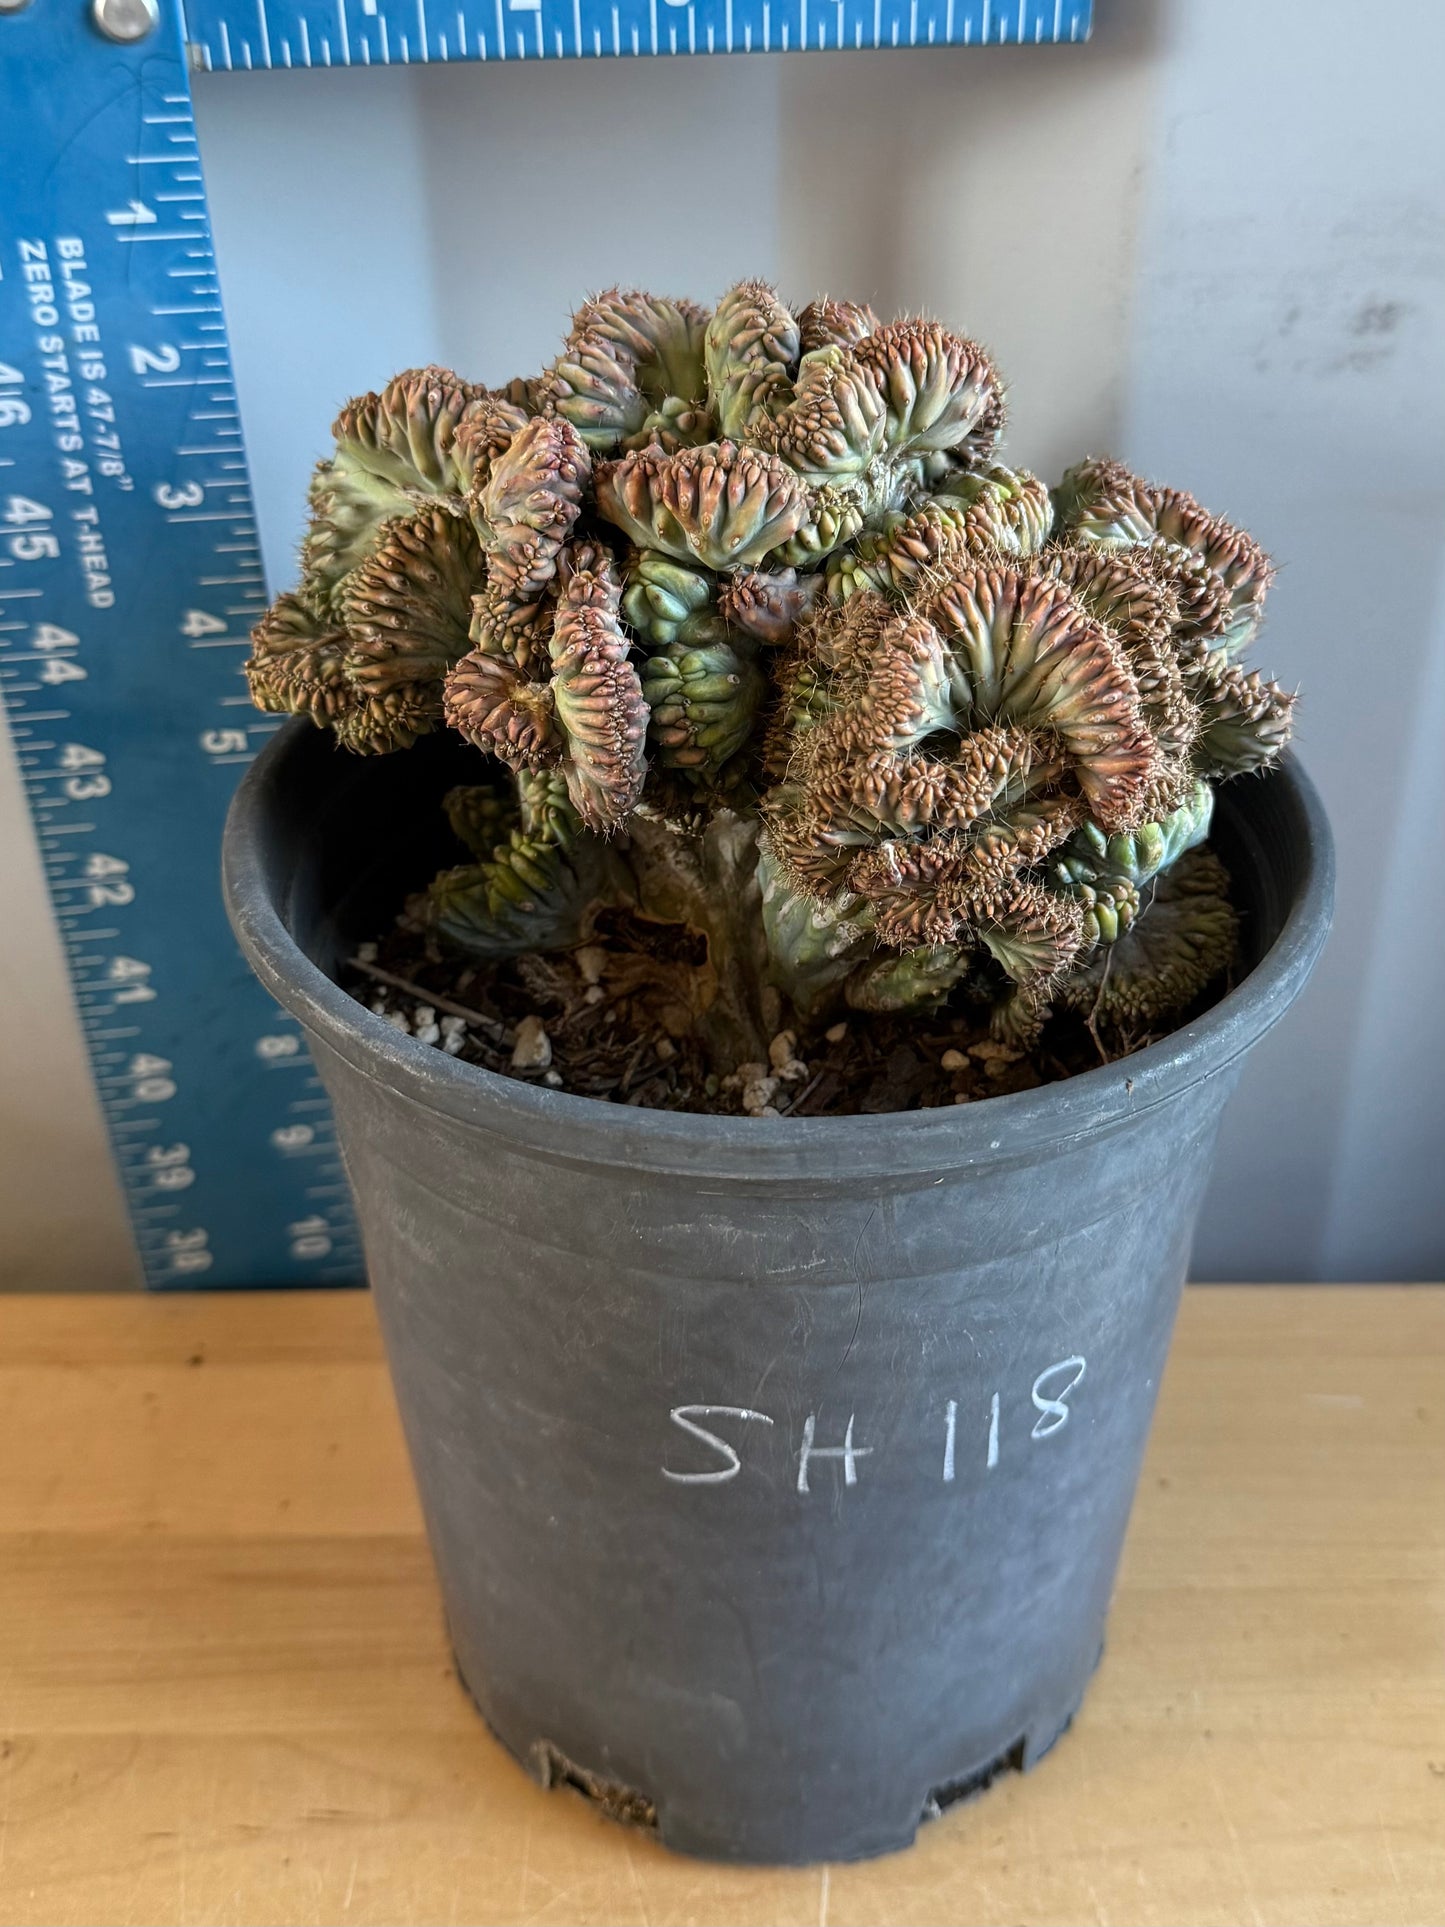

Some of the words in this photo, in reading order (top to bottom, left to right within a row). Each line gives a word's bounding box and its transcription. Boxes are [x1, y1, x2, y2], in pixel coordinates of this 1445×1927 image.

[105, 200, 157, 225] 1
[18, 238, 59, 328] ZERO
[57, 237, 101, 343] BLADE
[77, 350, 107, 380] IS
[129, 344, 181, 375] 2
[38, 334, 84, 452] STARTS
[61, 459, 94, 496] AT
[155, 481, 204, 510] 3
[4, 495, 61, 561] 45
[72, 505, 116, 609] T-HEAD
[180, 609, 229, 638] 4
[32, 622, 87, 686] 44
[201, 728, 249, 755] 5
[58, 742, 112, 801] 43
[86, 853, 136, 908] 42
[108, 955, 158, 1005] 41
[131, 1052, 178, 1103] 40
[271, 1124, 315, 1148] 9
[288, 1214, 333, 1259] 10
[942, 1354, 1088, 1483] 118
